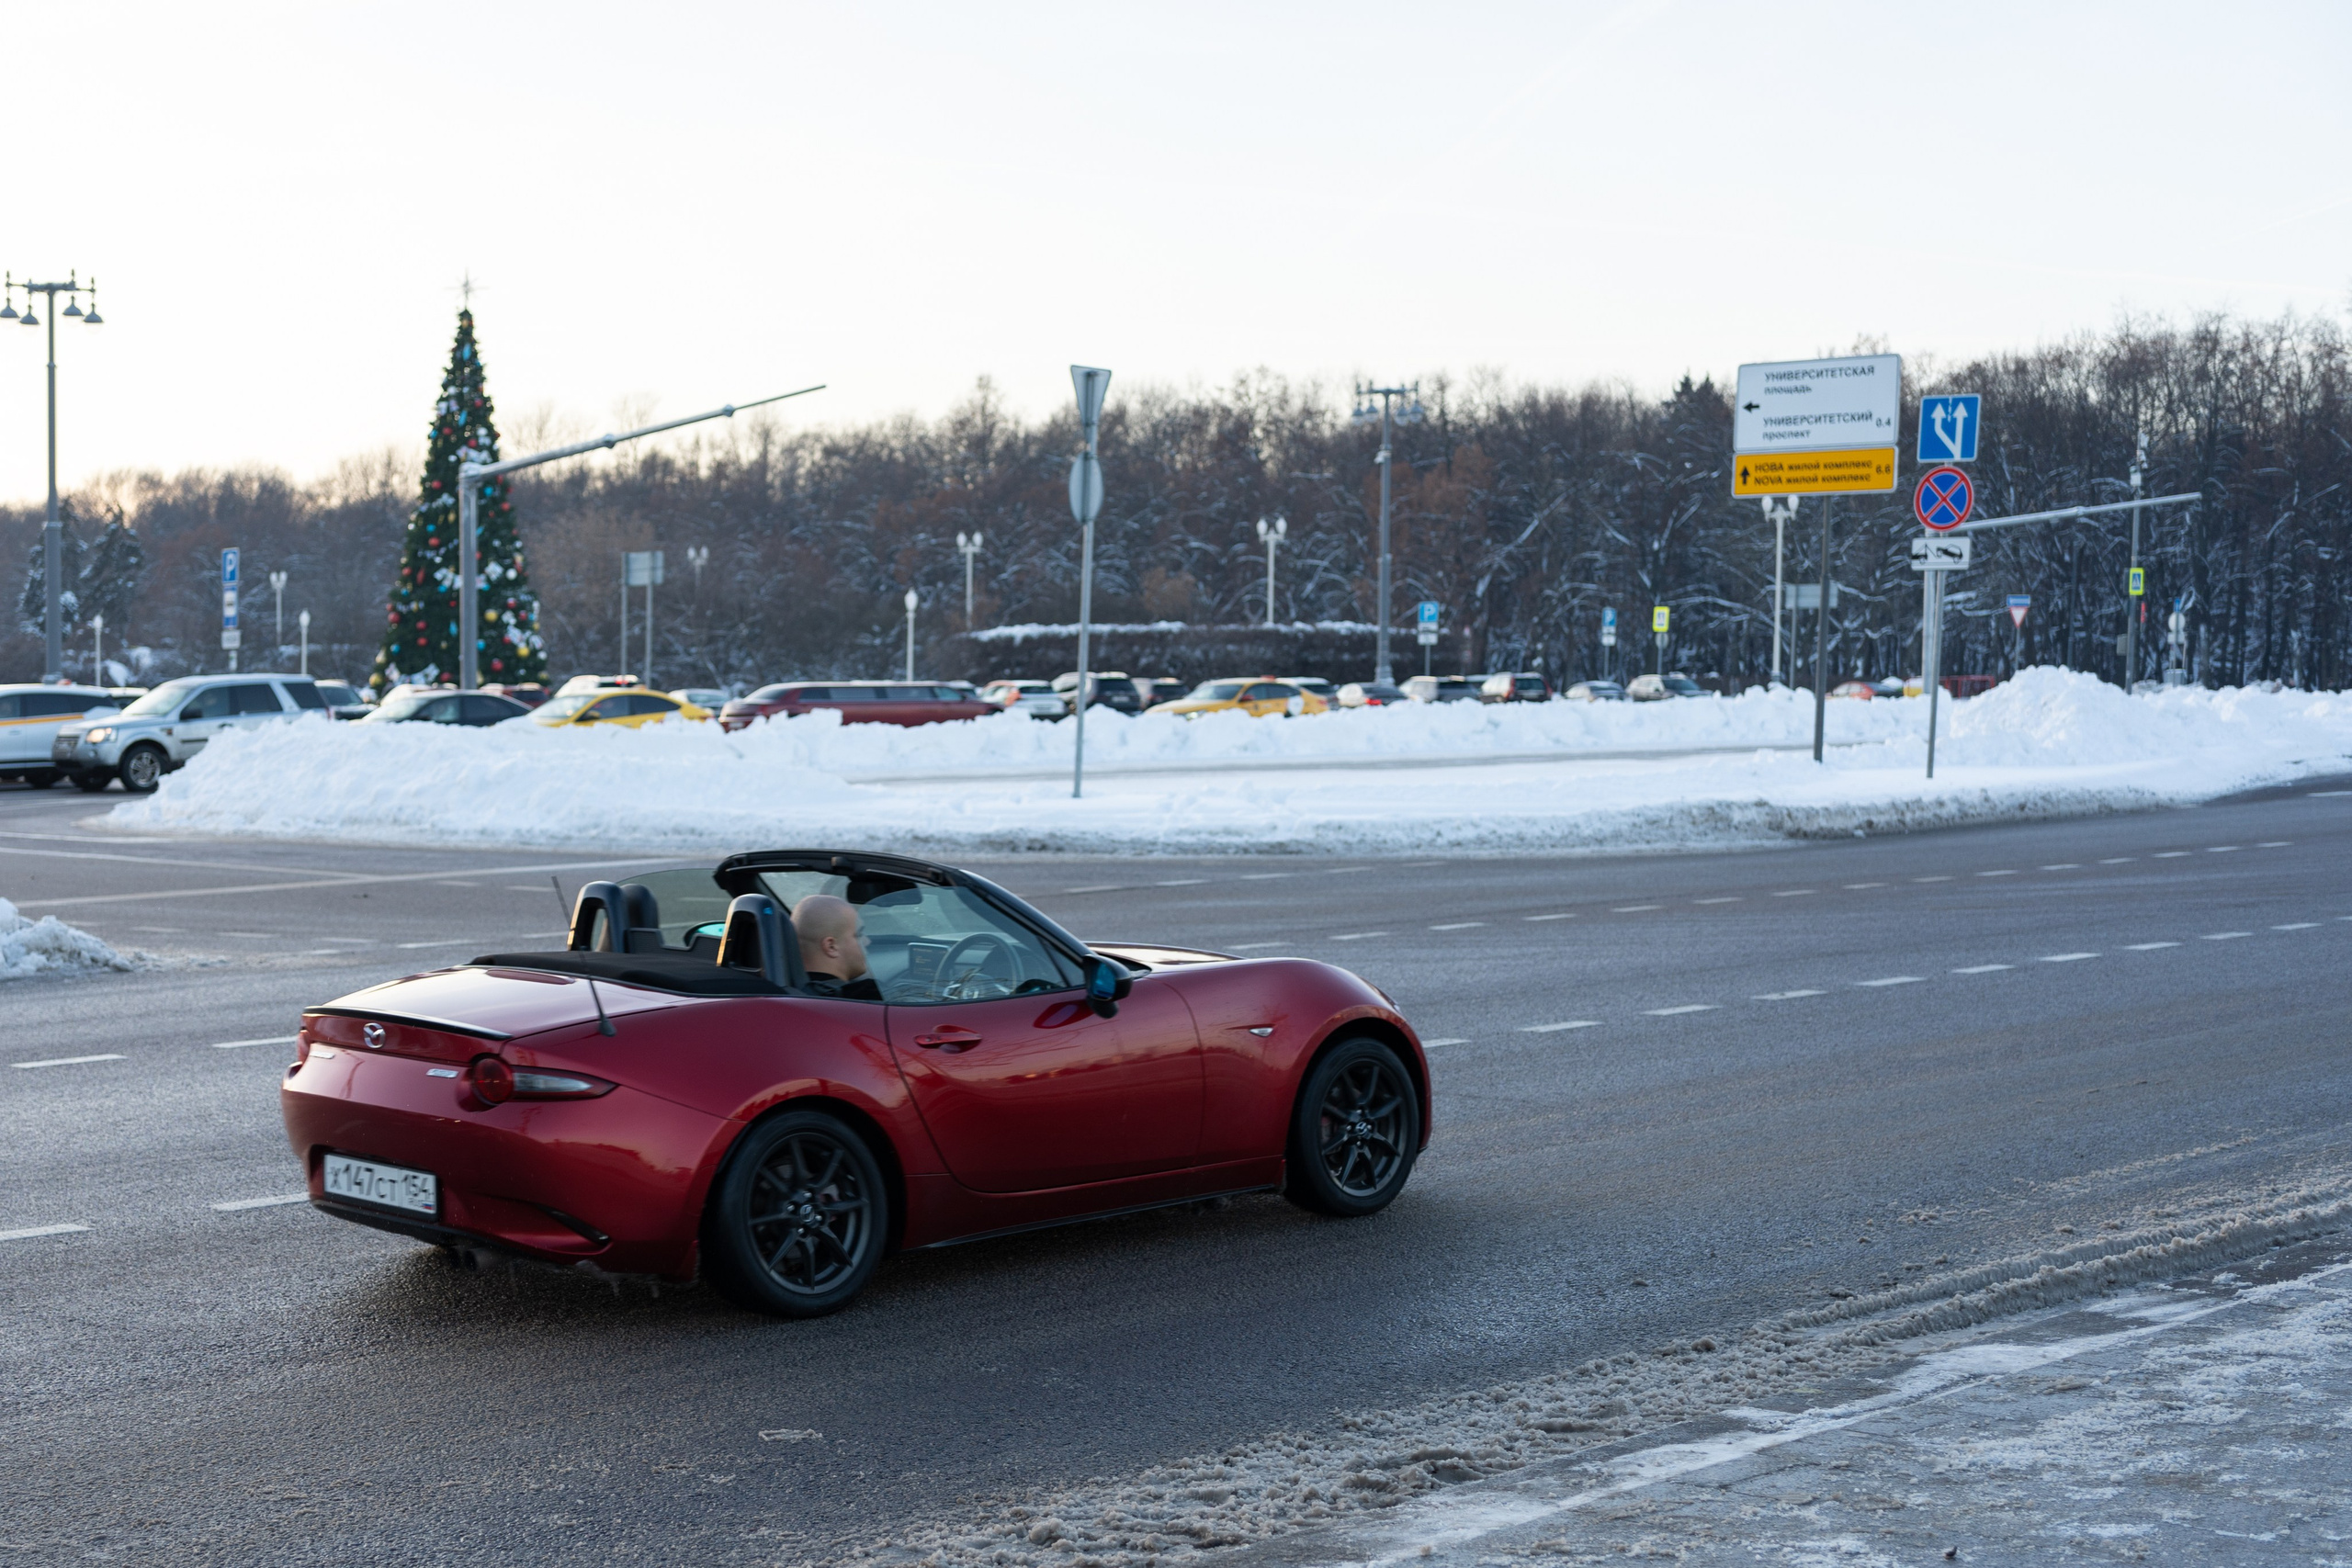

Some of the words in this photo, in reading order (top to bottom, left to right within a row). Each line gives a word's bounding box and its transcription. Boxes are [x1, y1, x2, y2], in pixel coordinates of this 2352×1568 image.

[1764, 365, 1875, 382] УНИВЕРСИТЕТСКАЯ
[1764, 385, 1813, 395] площадь
[1763, 410, 1872, 427] УНИВЕРСИТЕТСКИЙ
[1762, 429, 1811, 441] проспект
[1754, 461, 1784, 472] НОВА
[1786, 460, 1820, 471] жилой
[1823, 459, 1872, 470] комплекс
[1754, 474, 1783, 486] NOVA
[1785, 473, 1819, 484] жилой
[1821, 473, 1871, 484] комплекс
